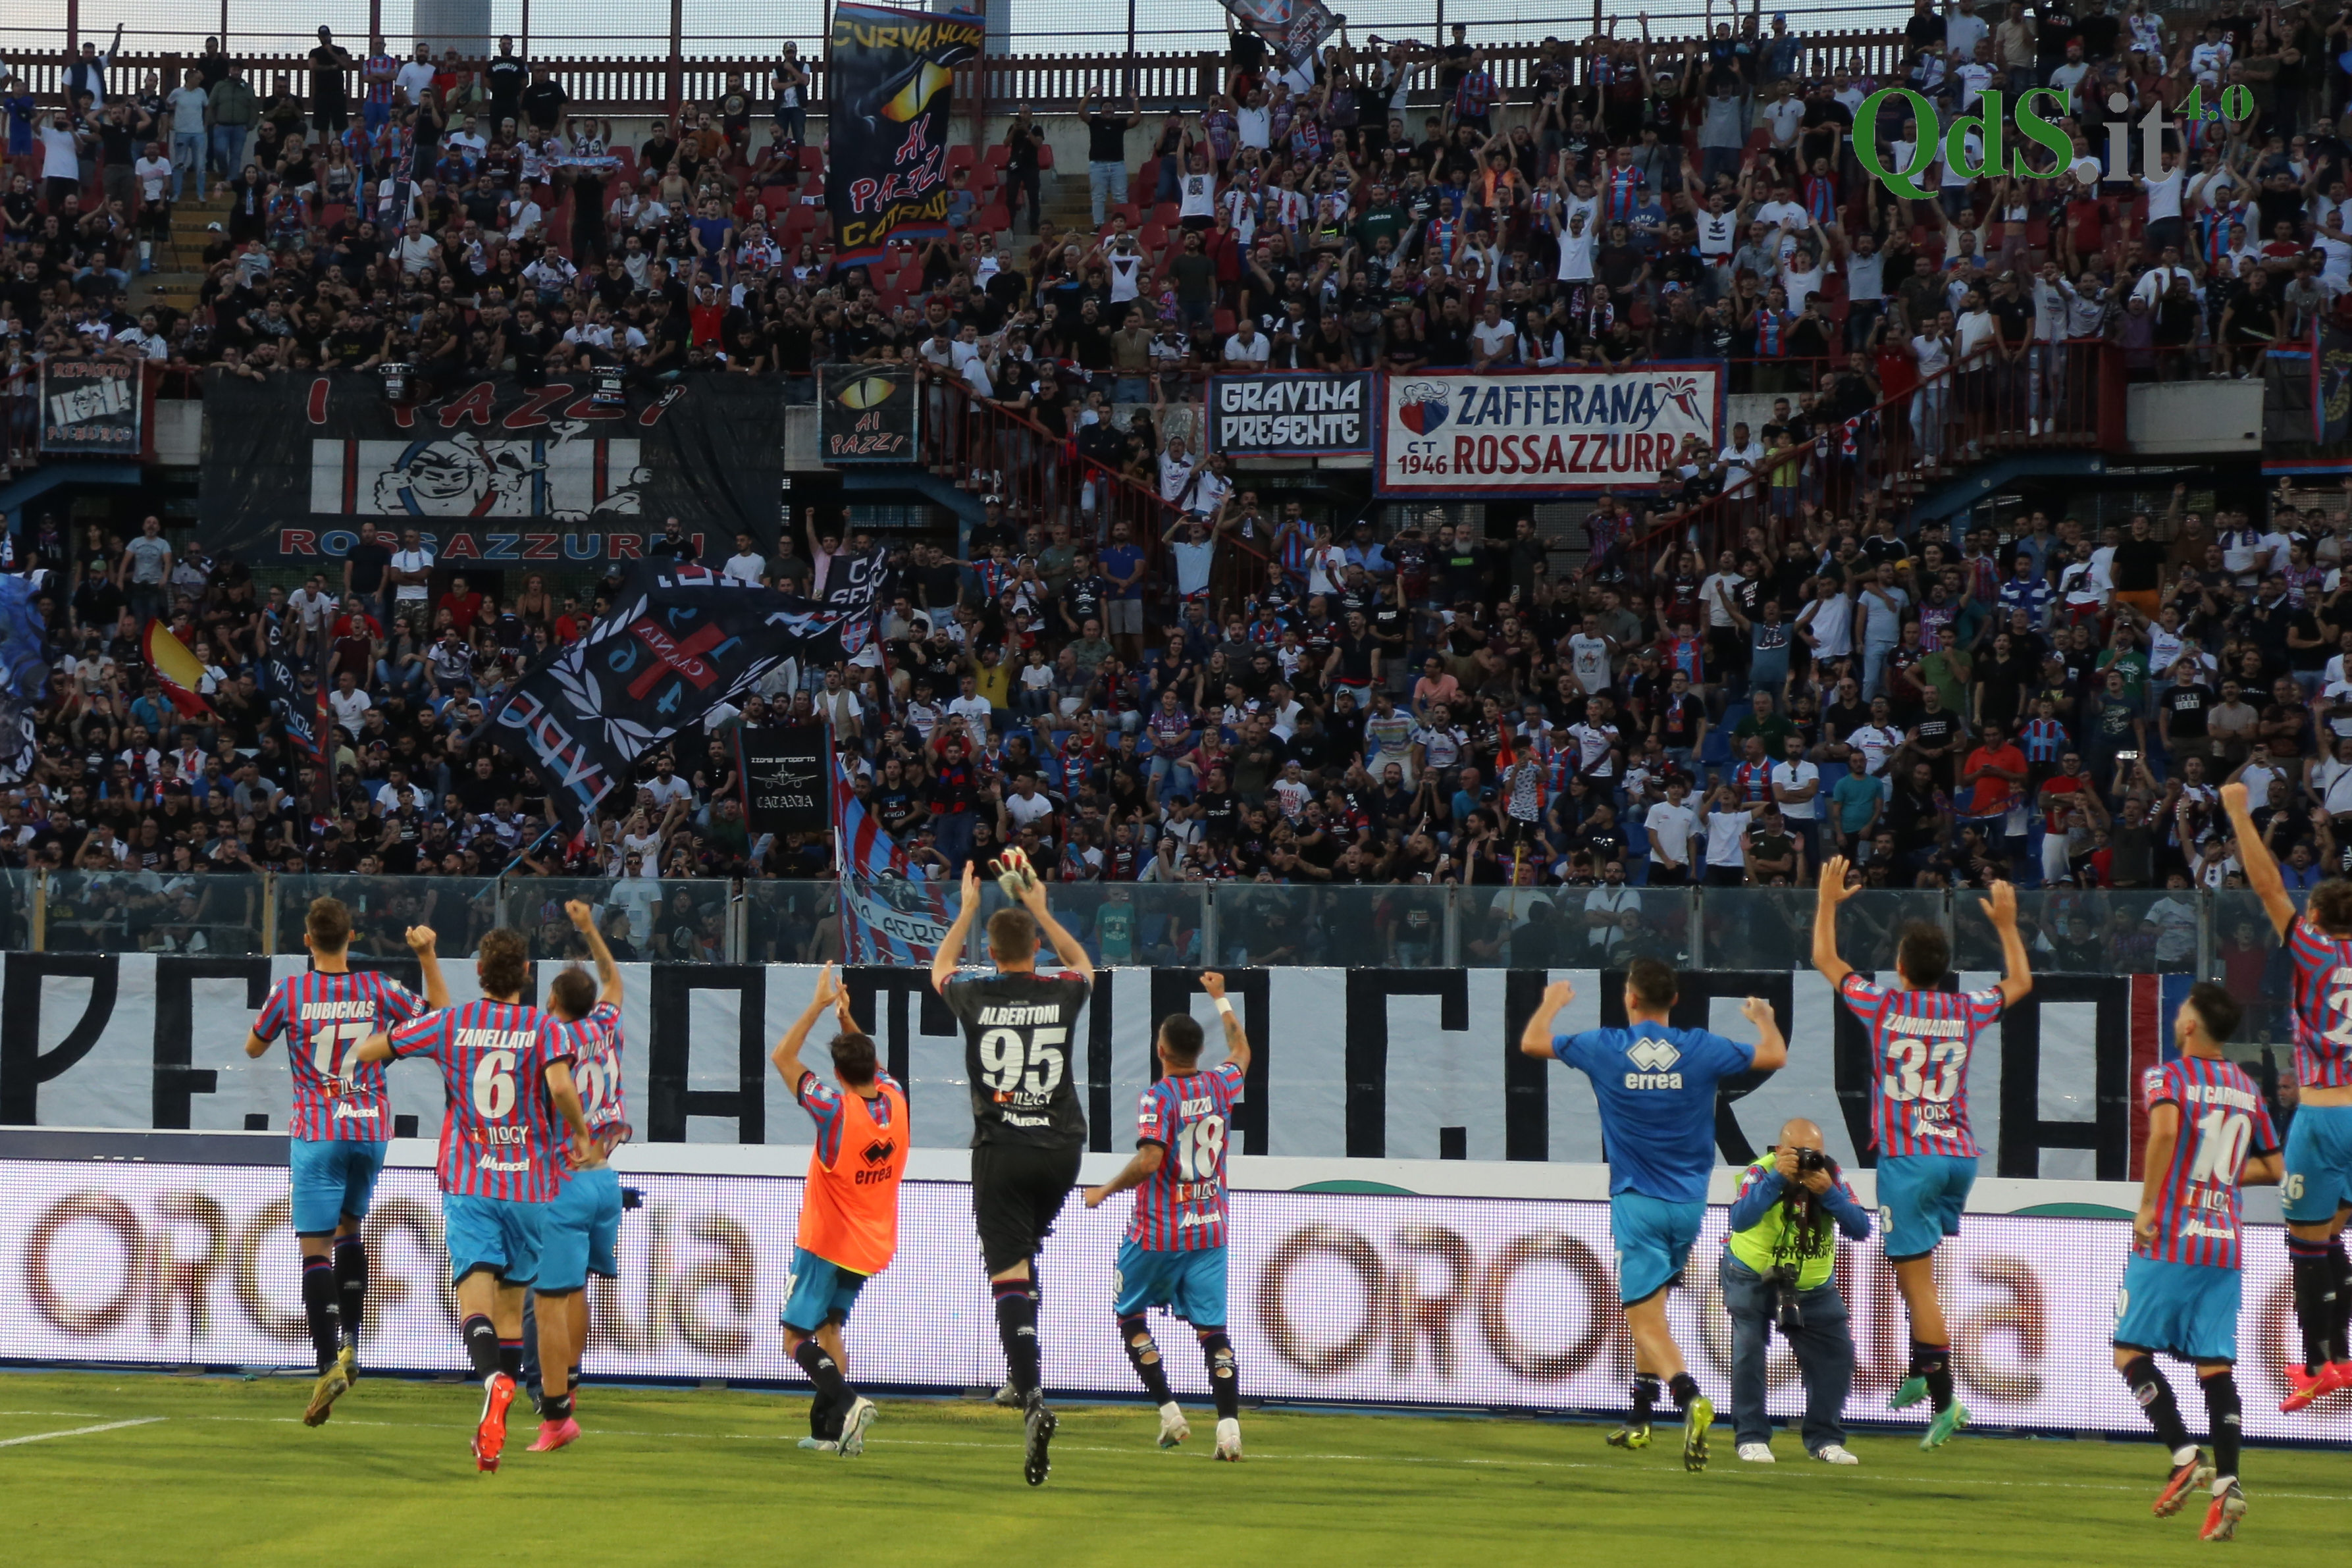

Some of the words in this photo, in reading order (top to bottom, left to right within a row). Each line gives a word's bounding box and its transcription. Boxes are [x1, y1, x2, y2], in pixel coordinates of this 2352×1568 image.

[833, 21, 931, 53] CURVA
[53, 362, 131, 379] REPARTO
[393, 382, 687, 428] AZZI
[1221, 380, 1361, 414] GRAVINA
[1455, 382, 1659, 432] ZAFFERANA
[855, 411, 880, 432] AI
[1220, 411, 1361, 447] PRESENTE
[831, 432, 904, 454] PAZZI
[1398, 454, 1448, 475] 1946
[756, 795, 814, 808] CATANIA
[301, 1000, 375, 1021] DUBICKAS
[978, 1005, 1060, 1025] ALBERTONI
[1882, 1012, 1966, 1038] ZAMMARINI
[453, 1028, 536, 1049] ZANELLATO
[311, 1021, 375, 1083] 17
[980, 1027, 1068, 1094] 95
[1625, 1071, 1683, 1091] errea
[1884, 1038, 1968, 1103] 33
[472, 1051, 516, 1119] 6
[1180, 1095, 1213, 1118] RIZZO
[1177, 1114, 1225, 1182] 18
[2191, 1109, 2253, 1186] 10
[855, 1163, 893, 1184] errea
